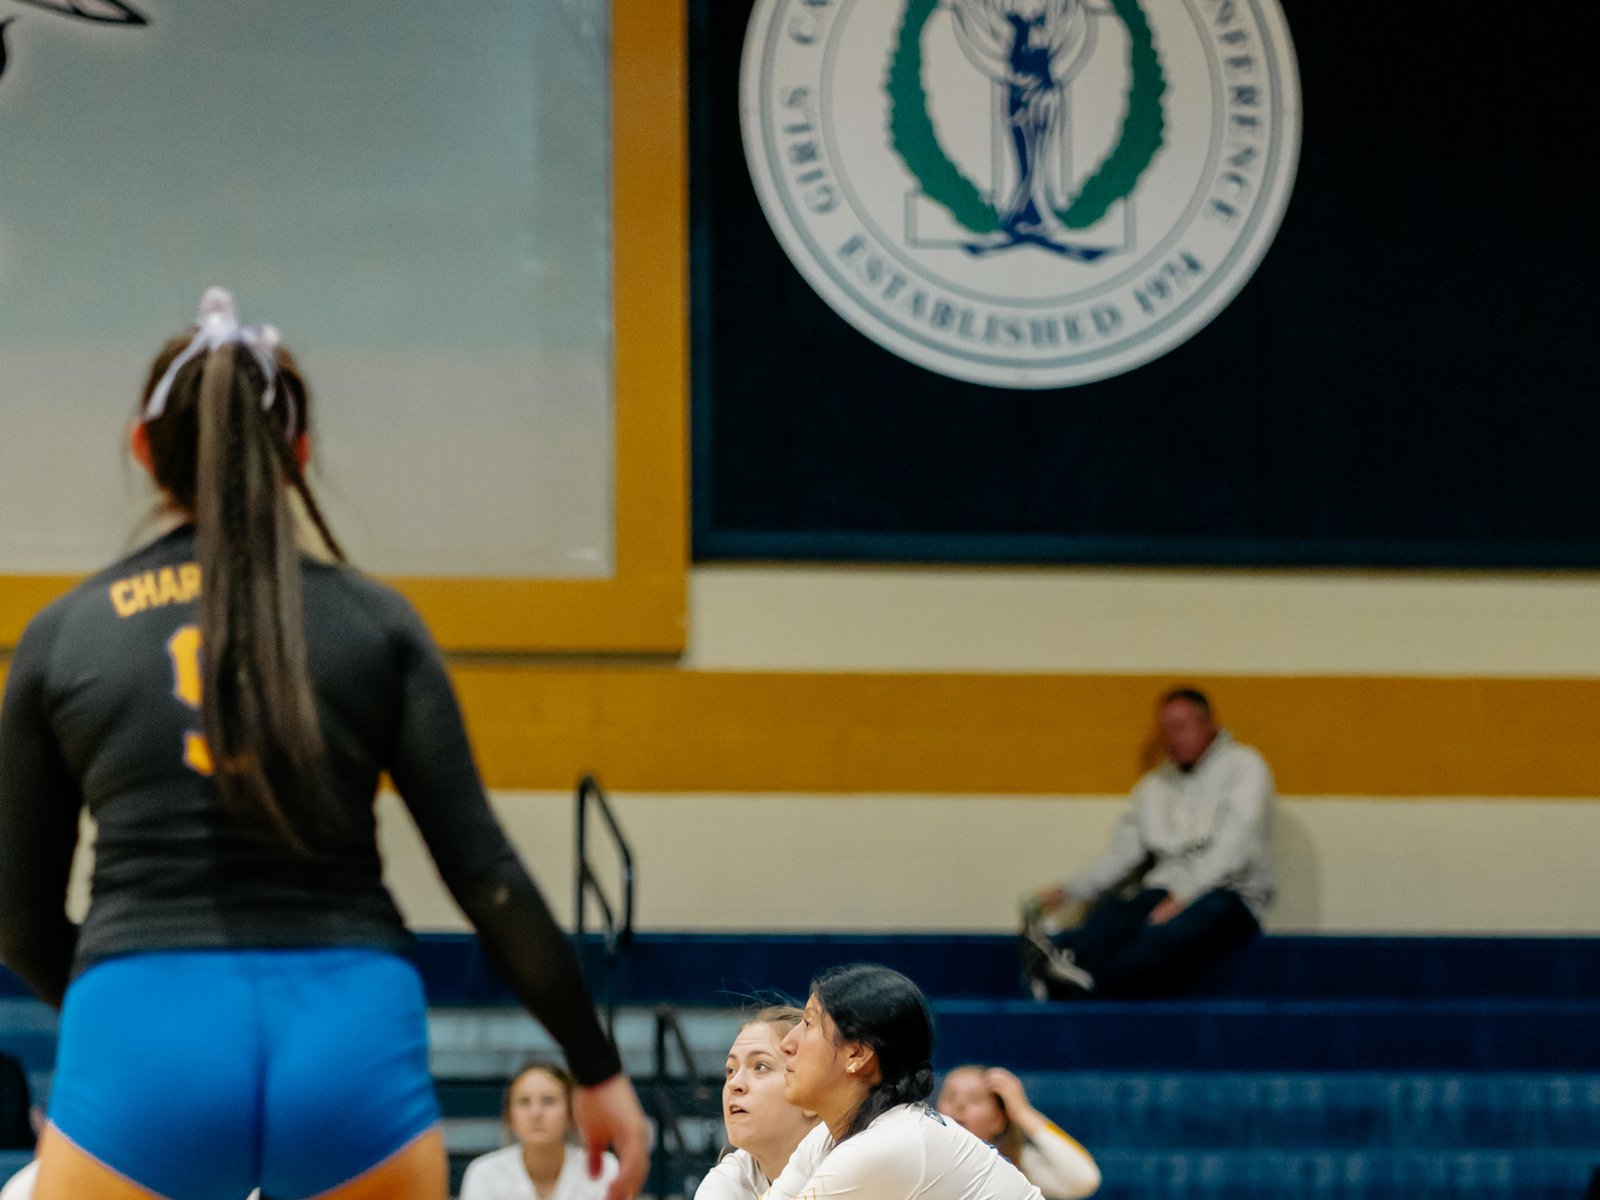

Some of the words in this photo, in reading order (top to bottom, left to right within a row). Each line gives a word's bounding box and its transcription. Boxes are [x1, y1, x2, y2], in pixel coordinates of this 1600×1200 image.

[780, 84, 839, 215] GIRLS
[837, 234, 1124, 349] ESTABLISHED
[1133, 249, 1204, 315] 1974
